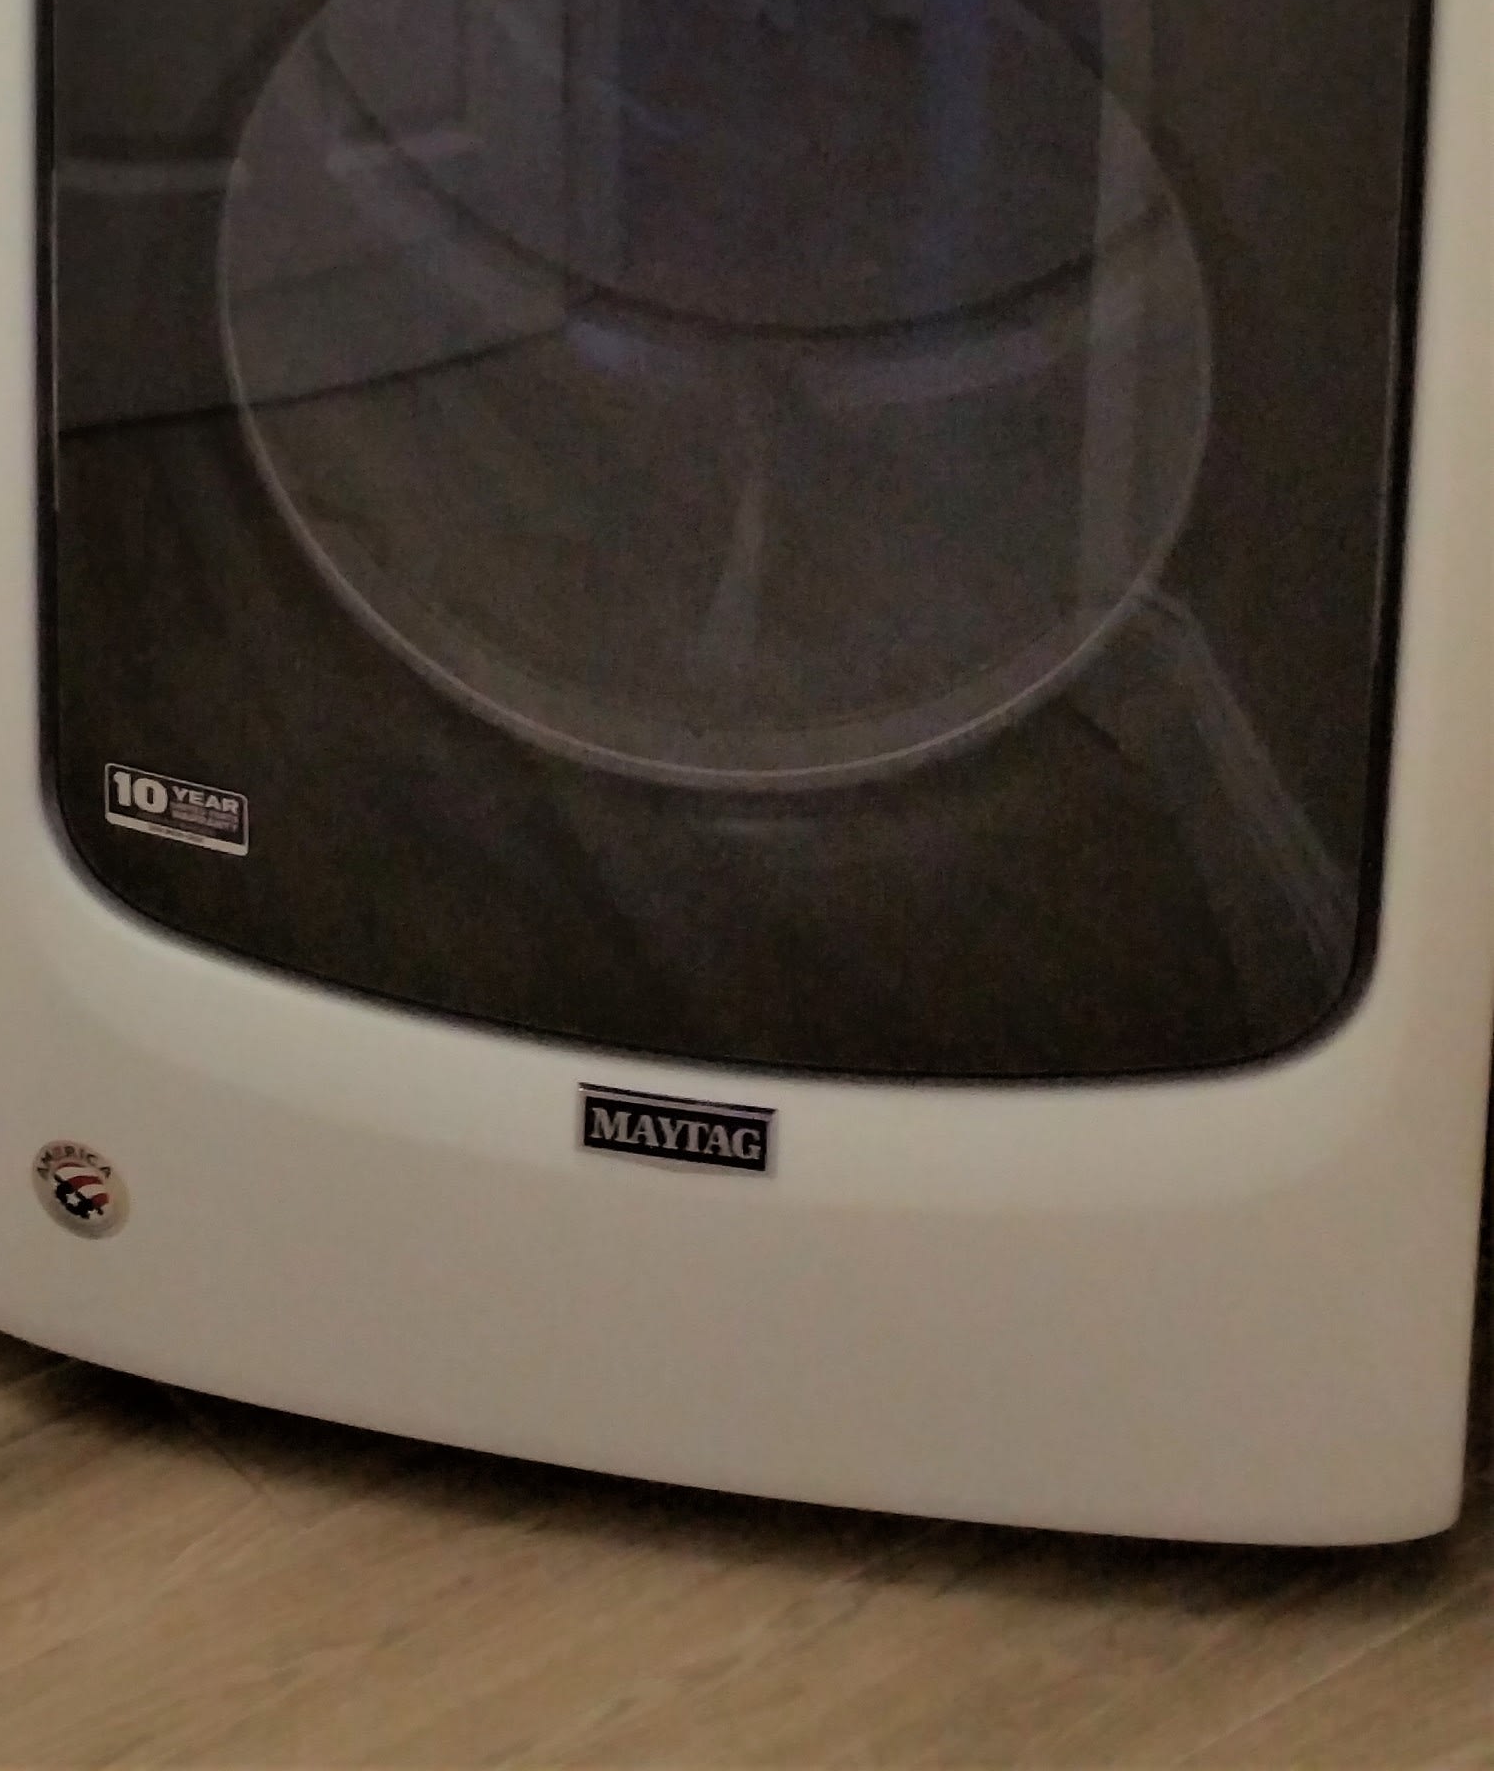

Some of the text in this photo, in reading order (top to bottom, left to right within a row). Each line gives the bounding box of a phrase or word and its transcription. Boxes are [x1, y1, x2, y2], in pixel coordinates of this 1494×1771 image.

[113, 770, 240, 815] 10 YEAR
[588, 1106, 762, 1160] MAYTAG
